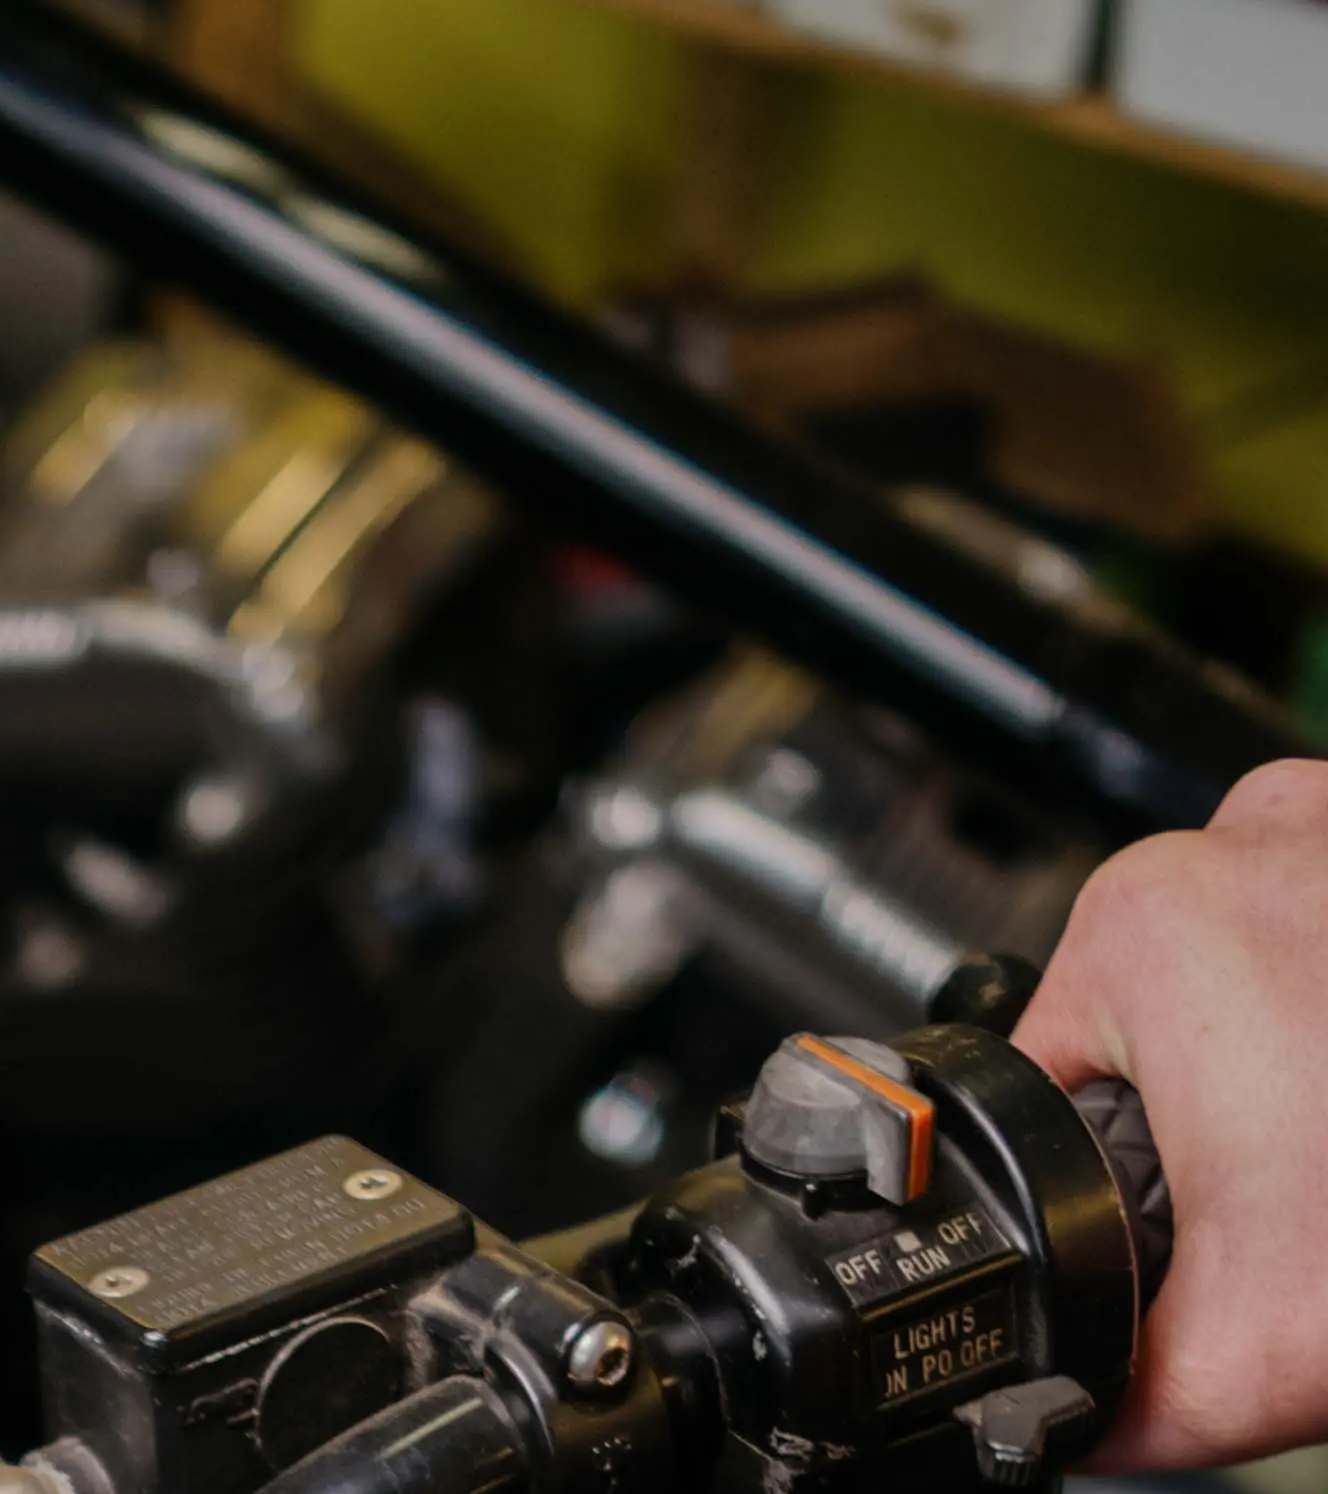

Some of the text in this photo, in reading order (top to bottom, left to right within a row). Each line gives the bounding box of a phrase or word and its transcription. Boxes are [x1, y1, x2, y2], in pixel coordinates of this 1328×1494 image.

[835, 1213, 982, 1285] OFF RUN OFF
[894, 1304, 976, 1359] LIGHTS
[922, 1349, 953, 1383] PO
[959, 1327, 1004, 1367] OFF
